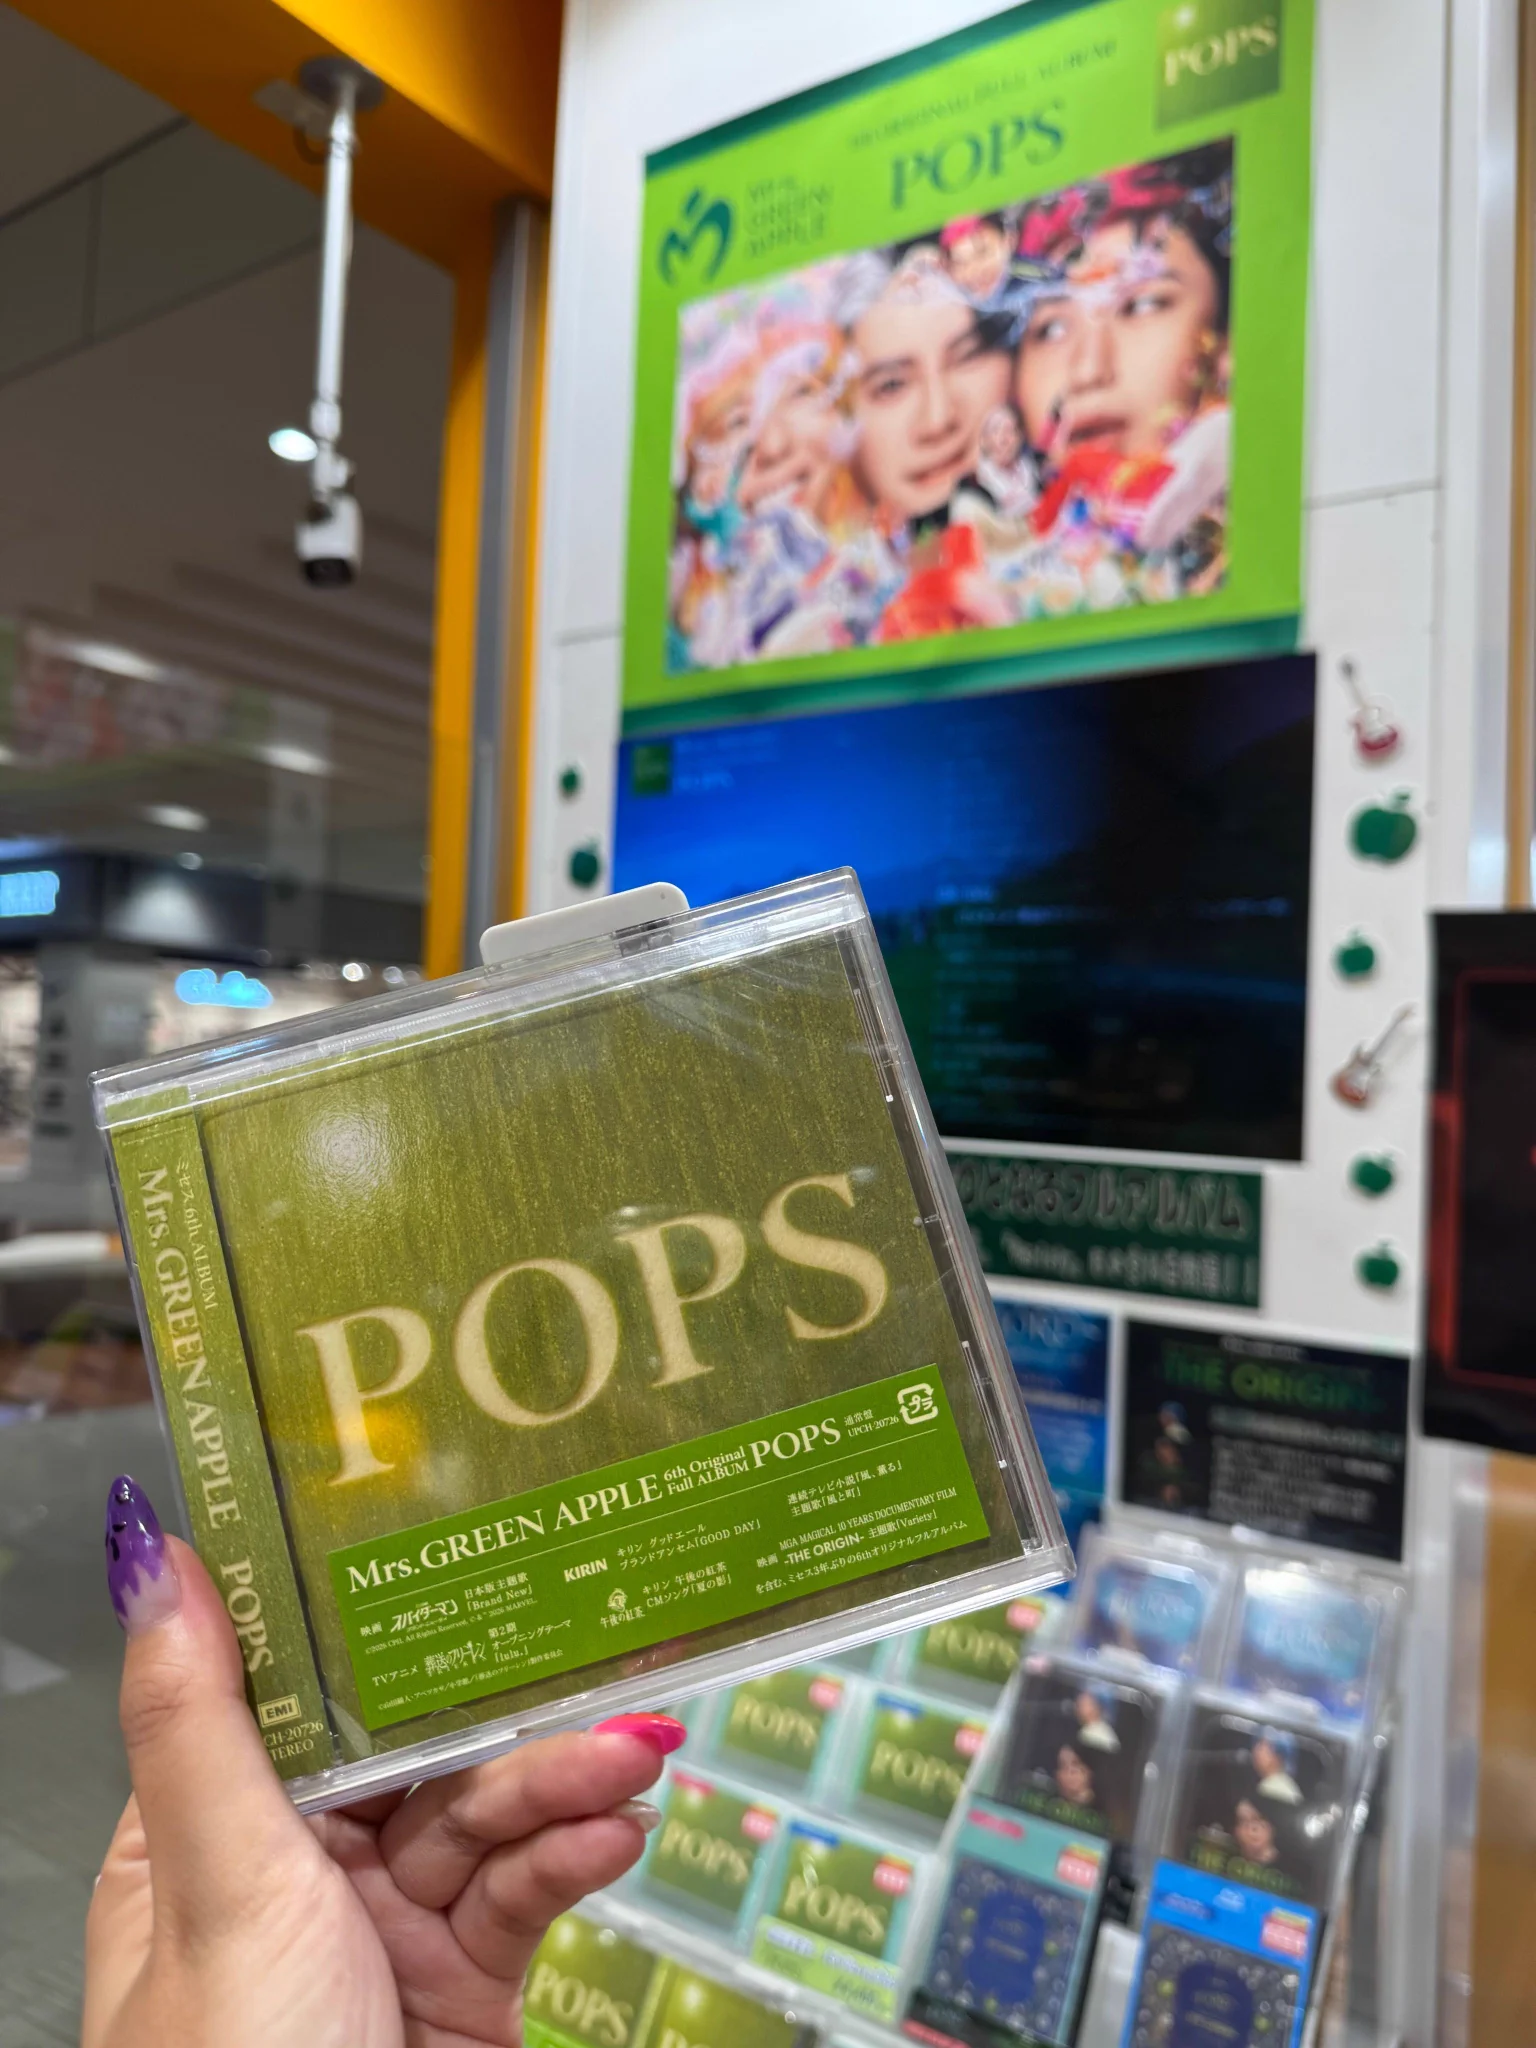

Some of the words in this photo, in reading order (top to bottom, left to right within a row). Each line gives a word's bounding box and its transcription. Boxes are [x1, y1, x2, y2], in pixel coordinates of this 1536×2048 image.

[1162, 15, 1281, 88] POPS
[889, 97, 1069, 211] POPS
[191, 1243, 219, 1310] ALBUM
[294, 1173, 890, 1487] POPS
[844, 1409, 874, 1427] 通常盤
[847, 1415, 900, 1437] UPCH-20726
[748, 1417, 842, 1469] POPS
[663, 1465, 688, 1481] 6th
[689, 1445, 747, 1473] Original
[666, 1475, 695, 1496] Full
[697, 1459, 750, 1487] ALBUM
[787, 1459, 903, 1505] 連続テレビ小説「風、薫る」
[553, 1473, 664, 1532] APPLE
[779, 1539, 798, 1552] MGA
[799, 1525, 837, 1545] MAGICAL
[847, 1512, 875, 1530] YEARS
[875, 1495, 936, 1522] DOCUMENTARY
[936, 1487, 958, 1503] FILM
[791, 1486, 862, 1518] 主題歌「風と町」
[184, 1396, 242, 1530] APPLE
[220, 1555, 275, 1673] POPS
[617, 1543, 643, 1558] キリン
[649, 1523, 707, 1549] グッドエール
[563, 1557, 608, 1583] KIRIN
[642, 1580, 670, 1596] キリン
[675, 1561, 728, 1586] 午後の紅茶
[756, 1553, 779, 1569] 映画
[464, 1572, 529, 1600] 日本版主題歌
[467, 1593, 503, 1612] 「Brand
[506, 1585, 533, 1600] New」
[646, 1573, 732, 1609] CMソング「夏の影」
[360, 1621, 383, 1637] 映画
[488, 1622, 517, 1640] 第2期
[491, 1619, 573, 1650] オープニングテーマ
[600, 1605, 646, 1629] 午後の紅茶
[372, 1664, 419, 1687] TVアニメ
[265, 1702, 293, 1719] EMI
[729, 1693, 820, 1751] POPS
[263, 1720, 324, 1747] CH-20726
[270, 1738, 314, 1761] TEREO
[659, 1818, 752, 1886] POPS
[781, 1873, 890, 1944] POPS
[527, 1960, 634, 2046] POPS
